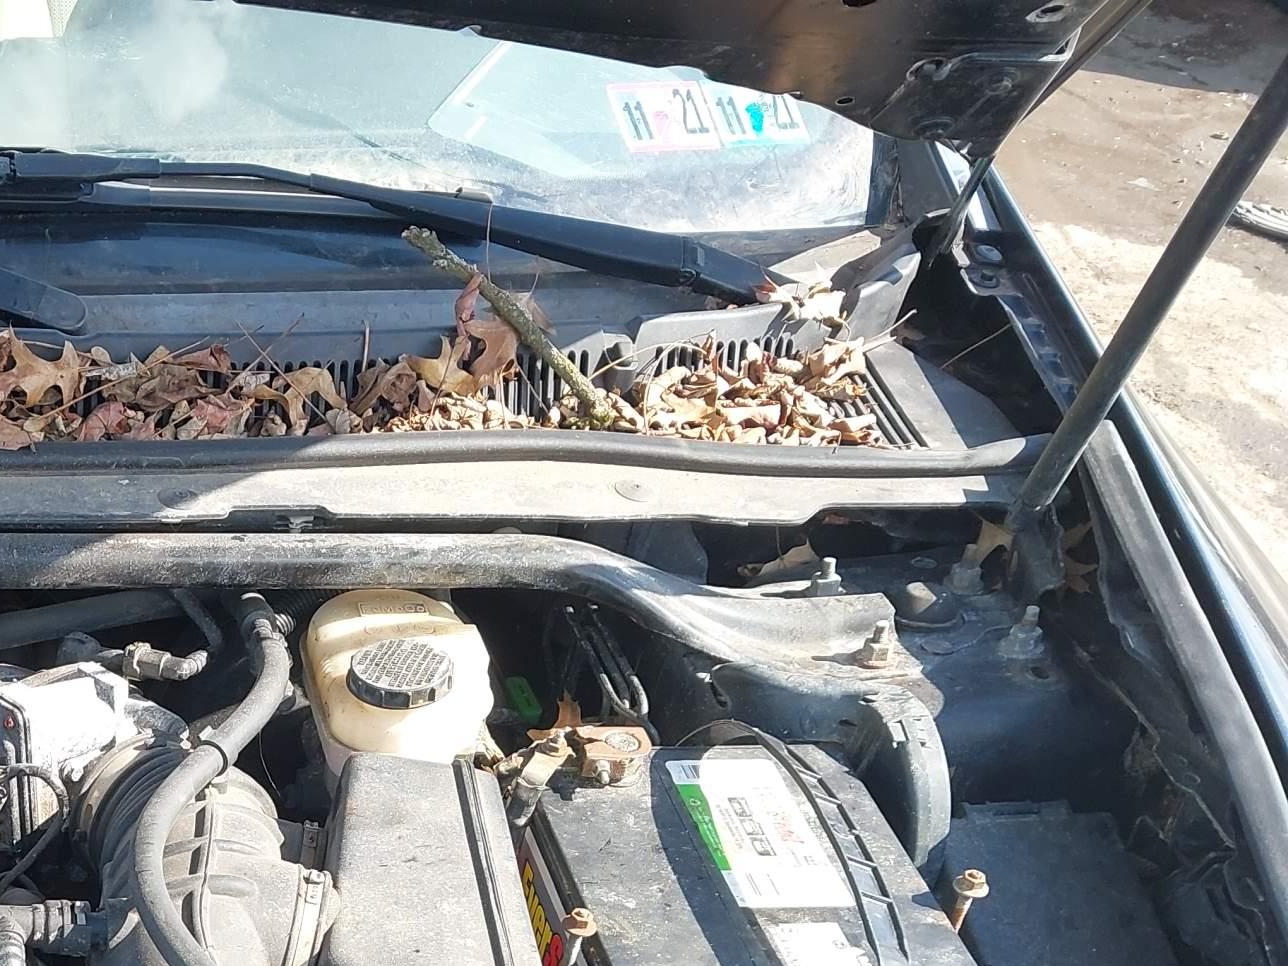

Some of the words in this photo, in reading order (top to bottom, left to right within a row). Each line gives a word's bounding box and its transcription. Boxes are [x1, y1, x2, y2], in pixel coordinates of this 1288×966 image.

[623, 101, 655, 140] 11
[672, 88, 710, 134] 21
[716, 96, 747, 135] 11
